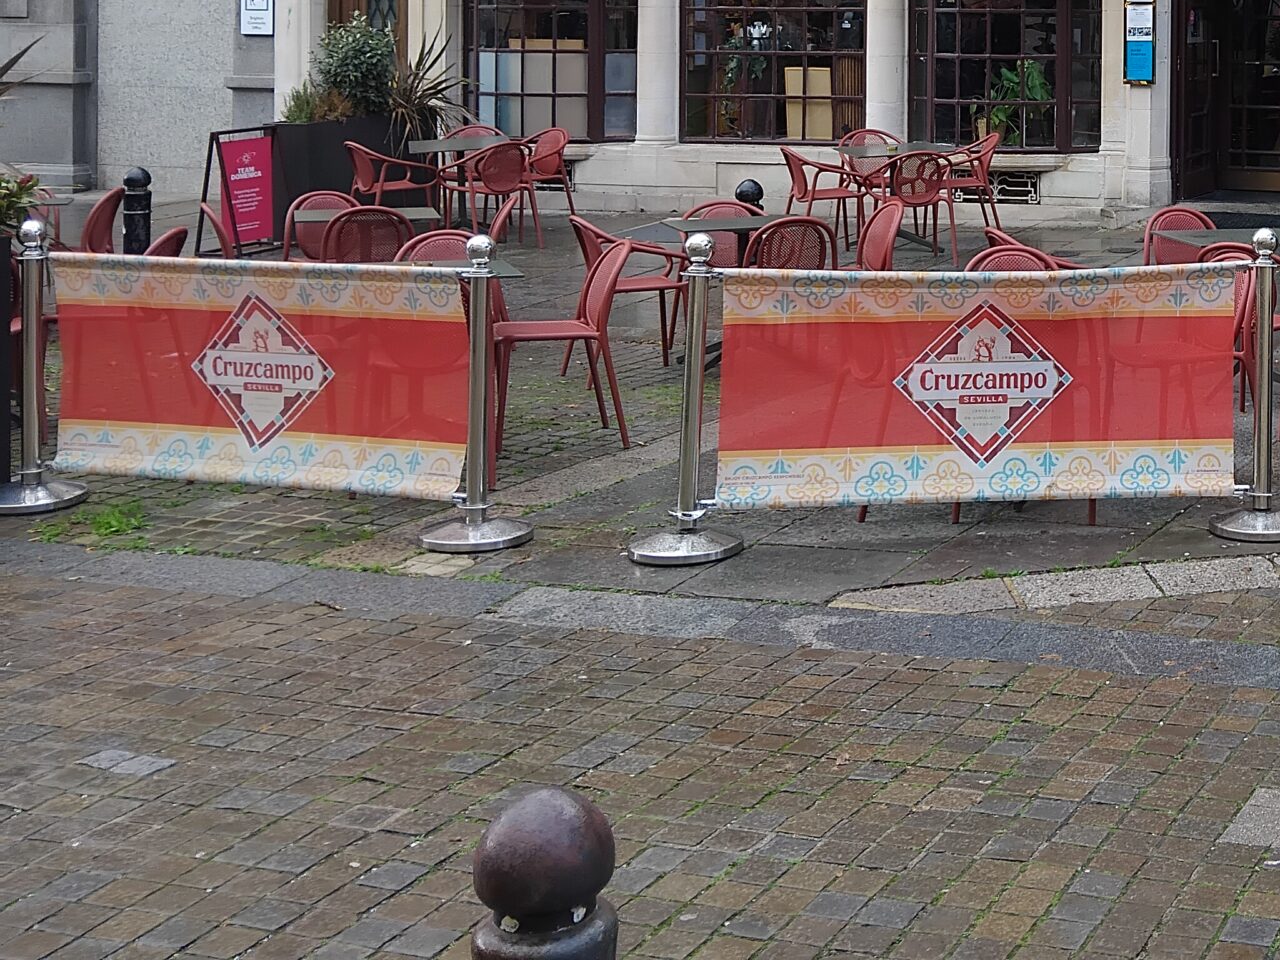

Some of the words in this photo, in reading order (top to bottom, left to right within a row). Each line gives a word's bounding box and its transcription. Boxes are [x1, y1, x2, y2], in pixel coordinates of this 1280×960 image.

[212, 354, 314, 384] Cruzcampo
[246, 383, 280, 392] SEVILLA
[919, 367, 1048, 393] Cruzcampo
[963, 395, 1004, 404] SEVILLA
